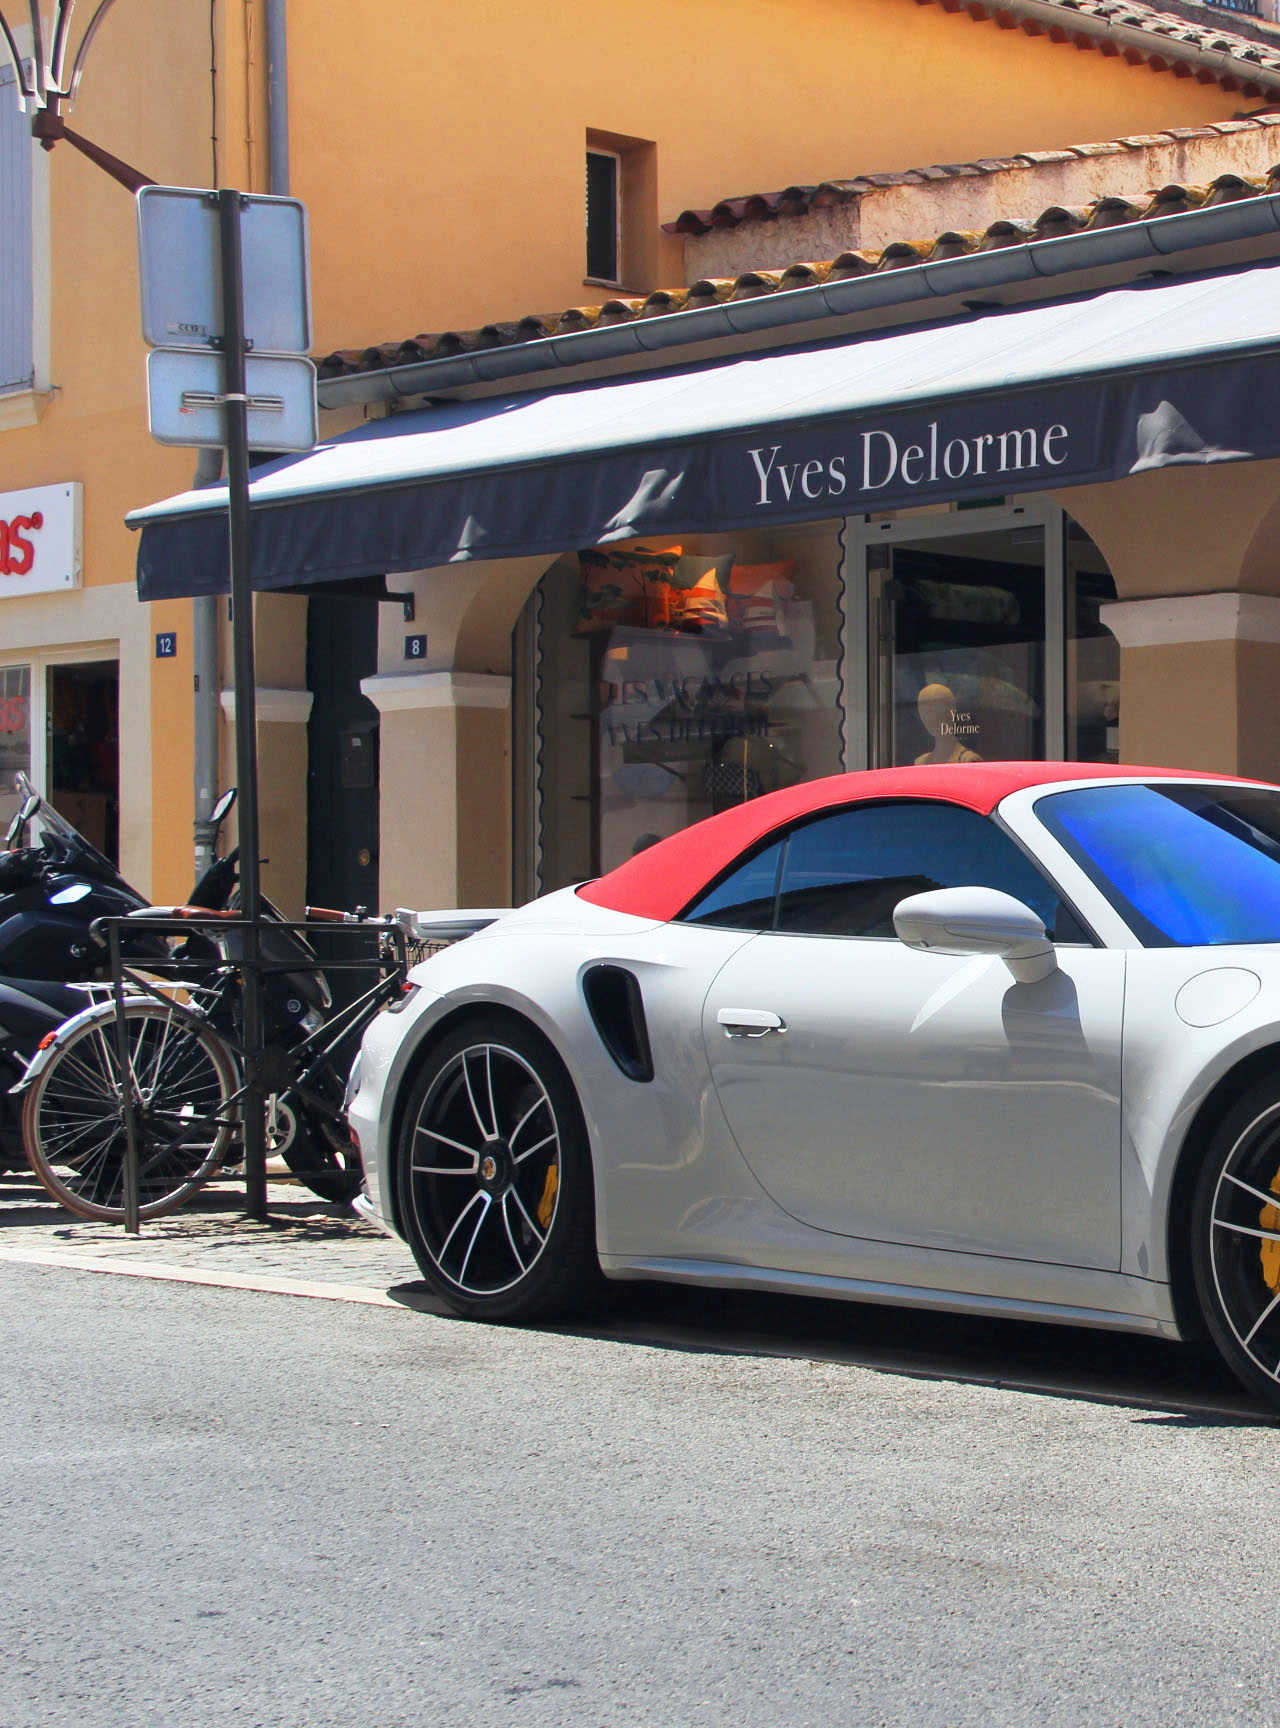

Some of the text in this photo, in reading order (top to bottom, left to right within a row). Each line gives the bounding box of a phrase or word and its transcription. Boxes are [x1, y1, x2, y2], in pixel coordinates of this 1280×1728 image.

[746, 421, 1069, 505] Yves Delorme
[159, 637, 172, 654] 12
[411, 639, 420, 656] 8
[949, 708, 972, 723] Yves
[940, 722, 981, 736] Delorme
